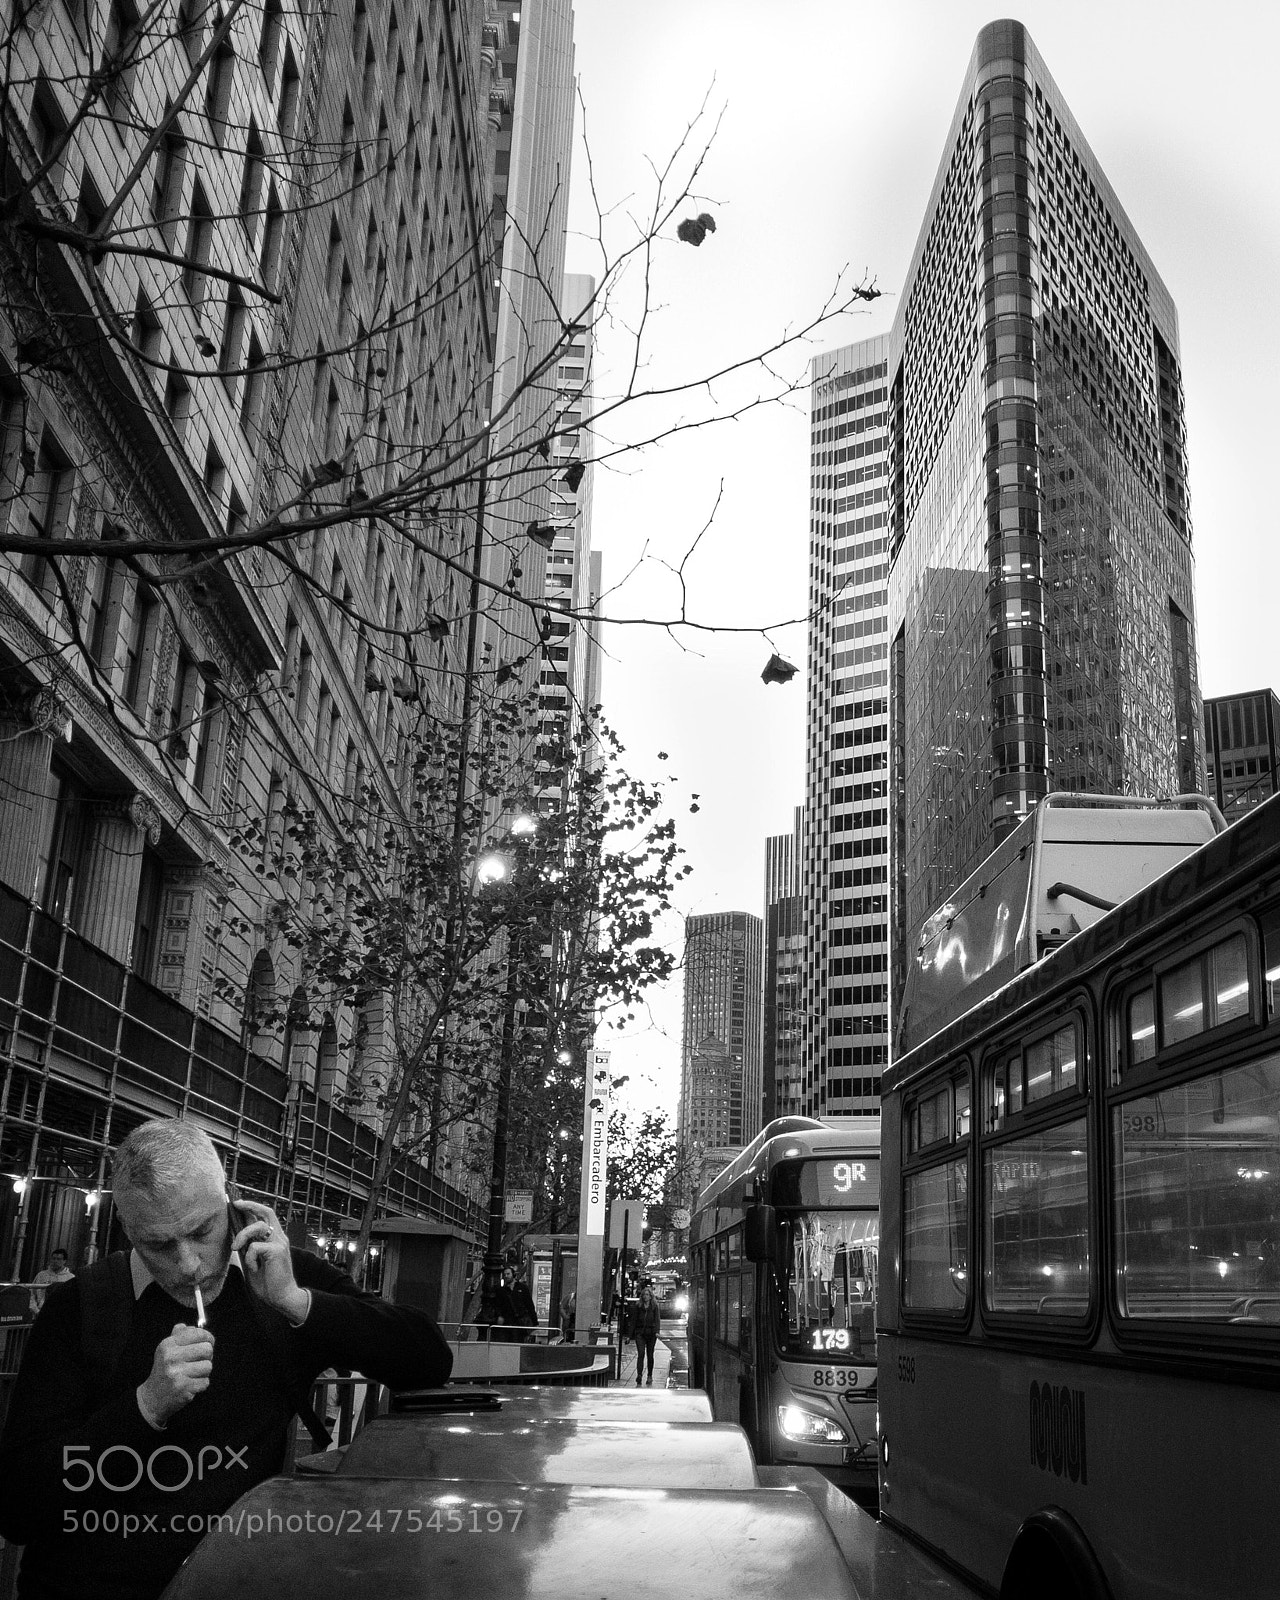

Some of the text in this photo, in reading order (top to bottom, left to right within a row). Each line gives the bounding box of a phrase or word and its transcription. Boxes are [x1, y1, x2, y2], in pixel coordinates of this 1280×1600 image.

[1073, 811, 1265, 964] VEHICLE
[591, 1120, 604, 1204] Embarcadero
[832, 1162, 867, 1192] 9R
[811, 1329, 851, 1350] 179
[813, 1370, 859, 1386] 8839
[898, 1355, 916, 1385] 5598
